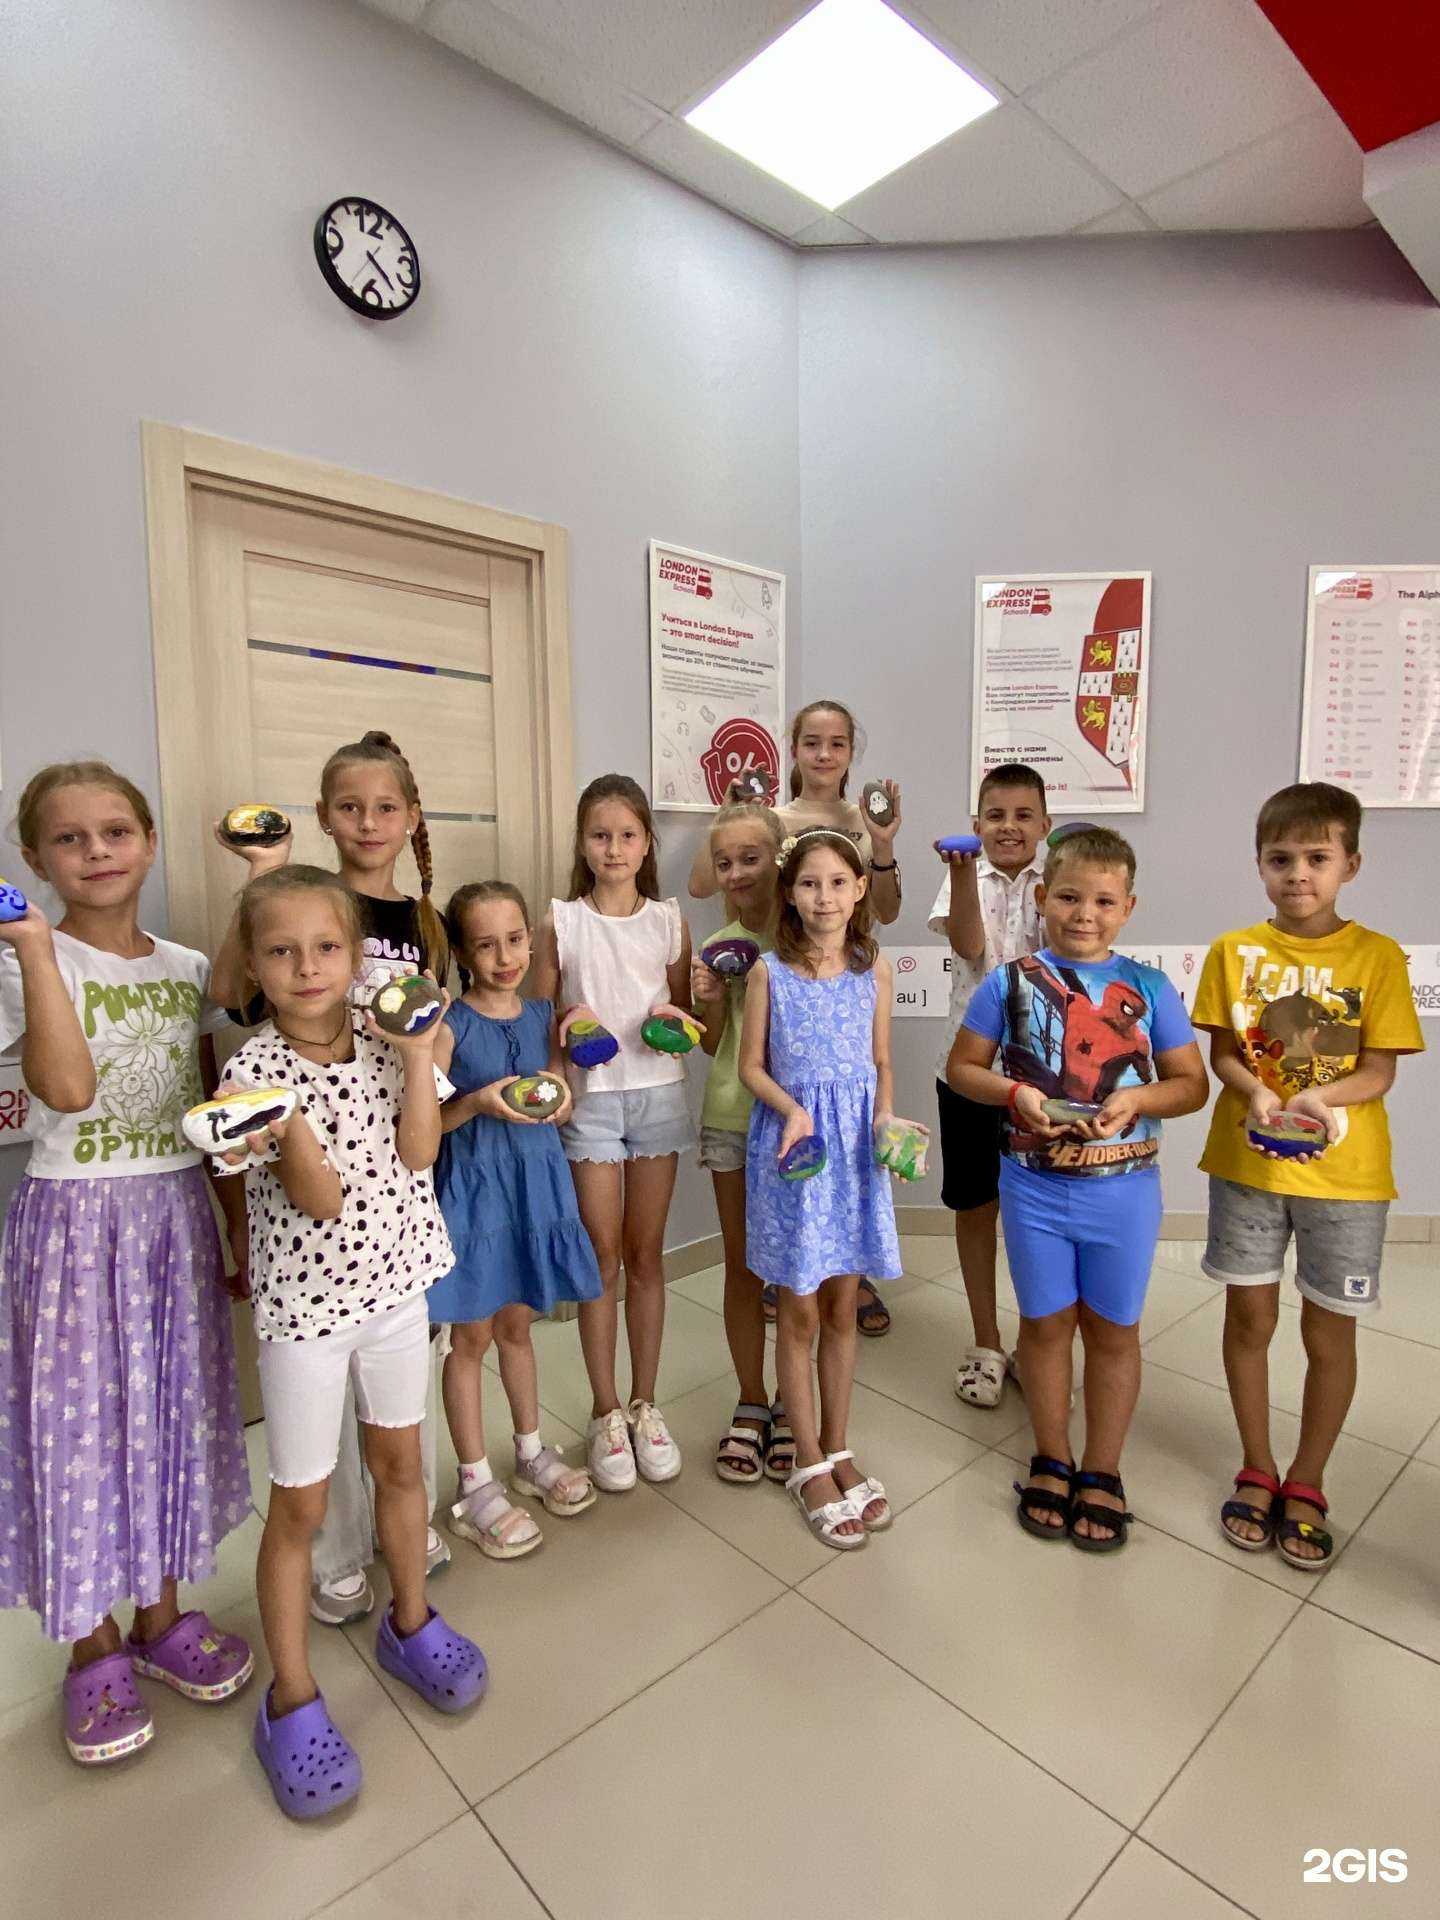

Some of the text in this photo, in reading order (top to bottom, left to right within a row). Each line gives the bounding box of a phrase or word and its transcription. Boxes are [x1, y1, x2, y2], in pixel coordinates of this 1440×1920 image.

[354, 204, 383, 240] 12
[328, 227, 343, 259] 9
[397, 256, 414, 289] 3
[361, 278, 383, 308] 6
[659, 569, 696, 586] EXPRESS
[661, 558, 698, 574] LONDON
[986, 599, 1030, 608] EXPRESS
[990, 588, 1033, 598] ONDON
[1397, 590, 1415, 598] The
[662, 613, 692, 627] Учиться
[700, 621, 726, 634] London
[728, 626, 754, 640] Express
[670, 629, 683, 637] это
[684, 631, 706, 642] smart
[707, 635, 739, 648] decision!
[1236, 944, 1334, 1003] TEAM
[78, 1116, 116, 1135] BY
[74, 1132, 188, 1163] OPTIM
